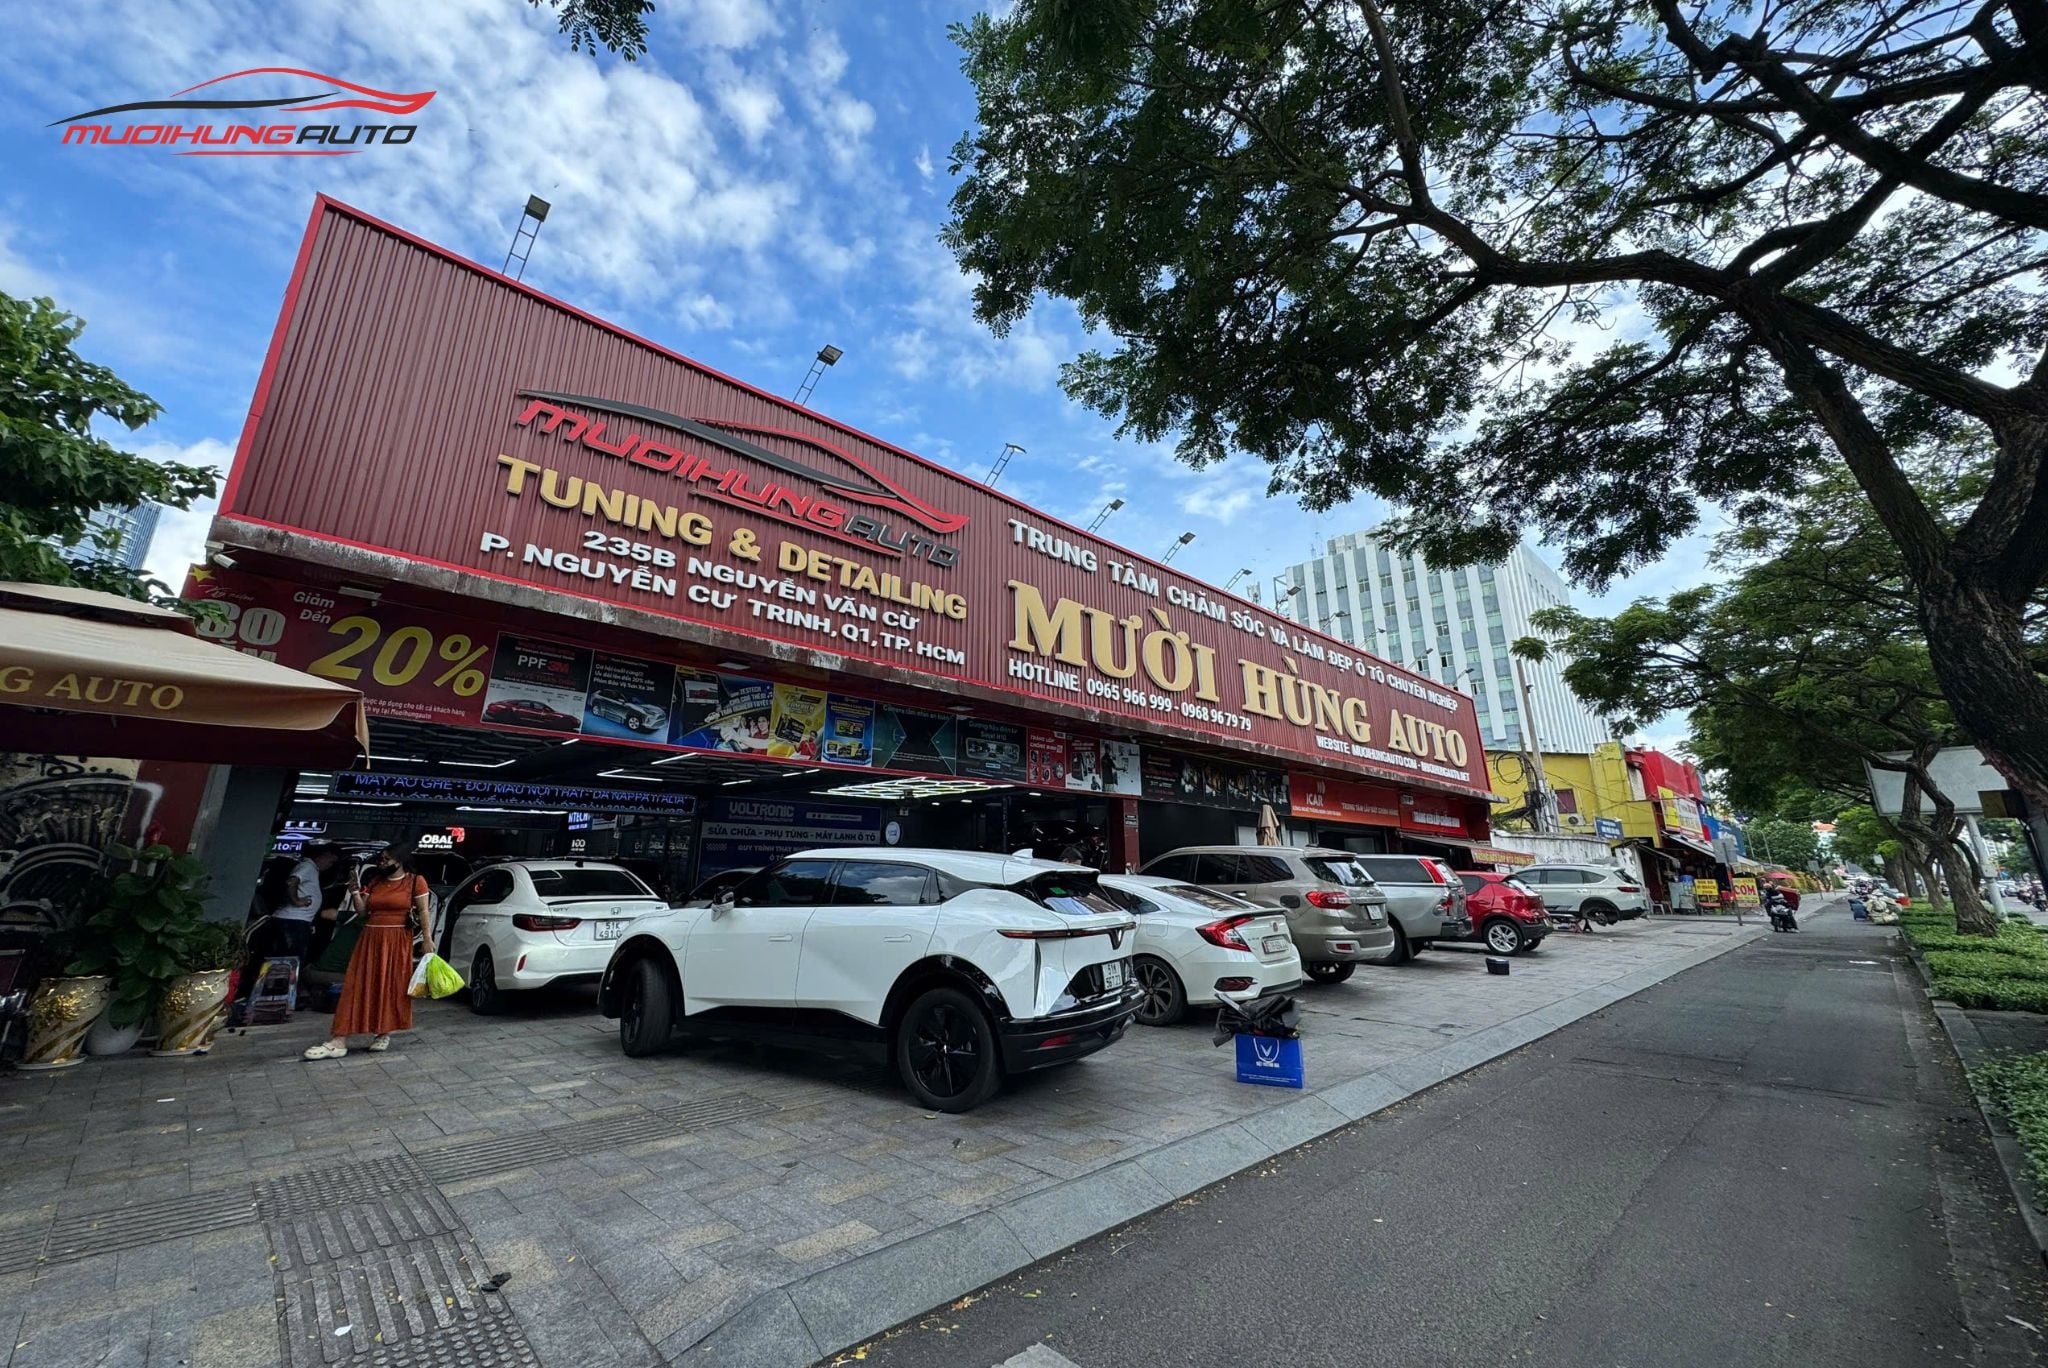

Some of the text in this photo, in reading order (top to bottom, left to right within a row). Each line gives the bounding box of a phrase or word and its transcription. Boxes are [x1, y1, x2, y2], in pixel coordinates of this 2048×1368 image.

[498, 453, 968, 620] TUNING & DETAILING
[479, 530, 514, 558] P.
[522, 543, 677, 597] NGUYỄN
[687, 584, 738, 610] CƯ
[583, 530, 920, 631] 235B NGUYỄN VĂN CỪ
[293, 591, 336, 609] Giảm
[299, 608, 332, 625] Đến
[1007, 517, 1098, 573] TRUNG
[1106, 559, 1160, 598] TÂM
[1166, 584, 1228, 623] CHĂM
[1229, 608, 1266, 639] SÓC
[1268, 622, 1290, 649] VÀ
[1291, 634, 1325, 662] LÀM
[1326, 649, 1353, 673] ĐẸP
[1353, 657, 1367, 677] Ô
[1367, 664, 1386, 685] TÔ
[1386, 672, 1427, 701] CHUYÊN
[306, 615, 489, 698] 20%
[516, 654, 548, 669] PPF
[1007, 578, 1469, 769] MƯỜI HÙNG AUTO
[45, 672, 184, 711] AUTO
[1086, 677, 1121, 702] 0965
[1122, 686, 1147, 708] 966
[1148, 693, 1173, 713] 999
[1180, 701, 1210, 724] 0968
[728, 801, 795, 818] VOLTRONIC
[1306, 792, 1324, 808] ICAR
[707, 823, 728, 836] SỬA
[730, 824, 757, 837] CHỮA
[764, 828, 783, 840] PHỤ
[785, 827, 809, 840] TÙNG
[815, 829, 833, 841] MÁY
[833, 832, 857, 843] LẠNH
[604, 920, 621, 930] 51K
